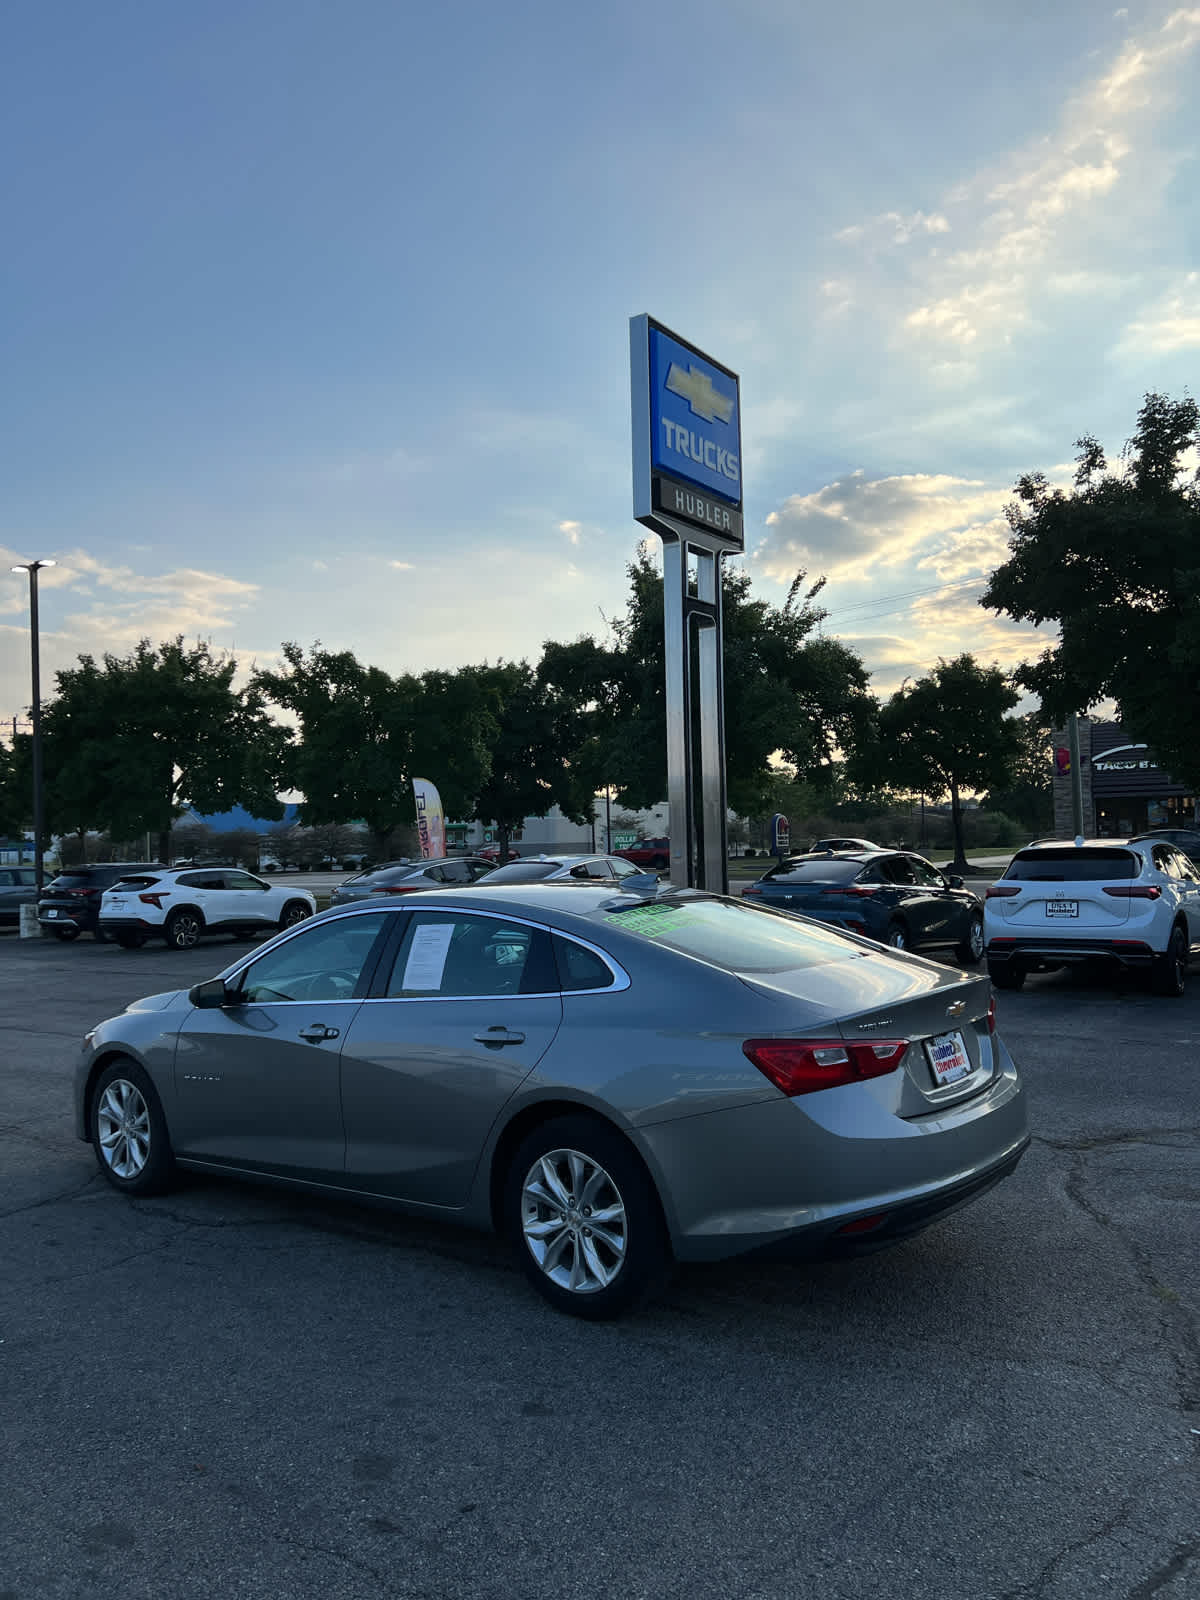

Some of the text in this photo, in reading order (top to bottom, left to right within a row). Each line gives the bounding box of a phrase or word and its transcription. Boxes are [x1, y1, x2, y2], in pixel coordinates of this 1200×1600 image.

[661, 416, 739, 480] TRUCKS
[675, 489, 732, 530] HUBLER
[930, 1044, 953, 1062] Hubler
[935, 1054, 966, 1074] Chevrolet
